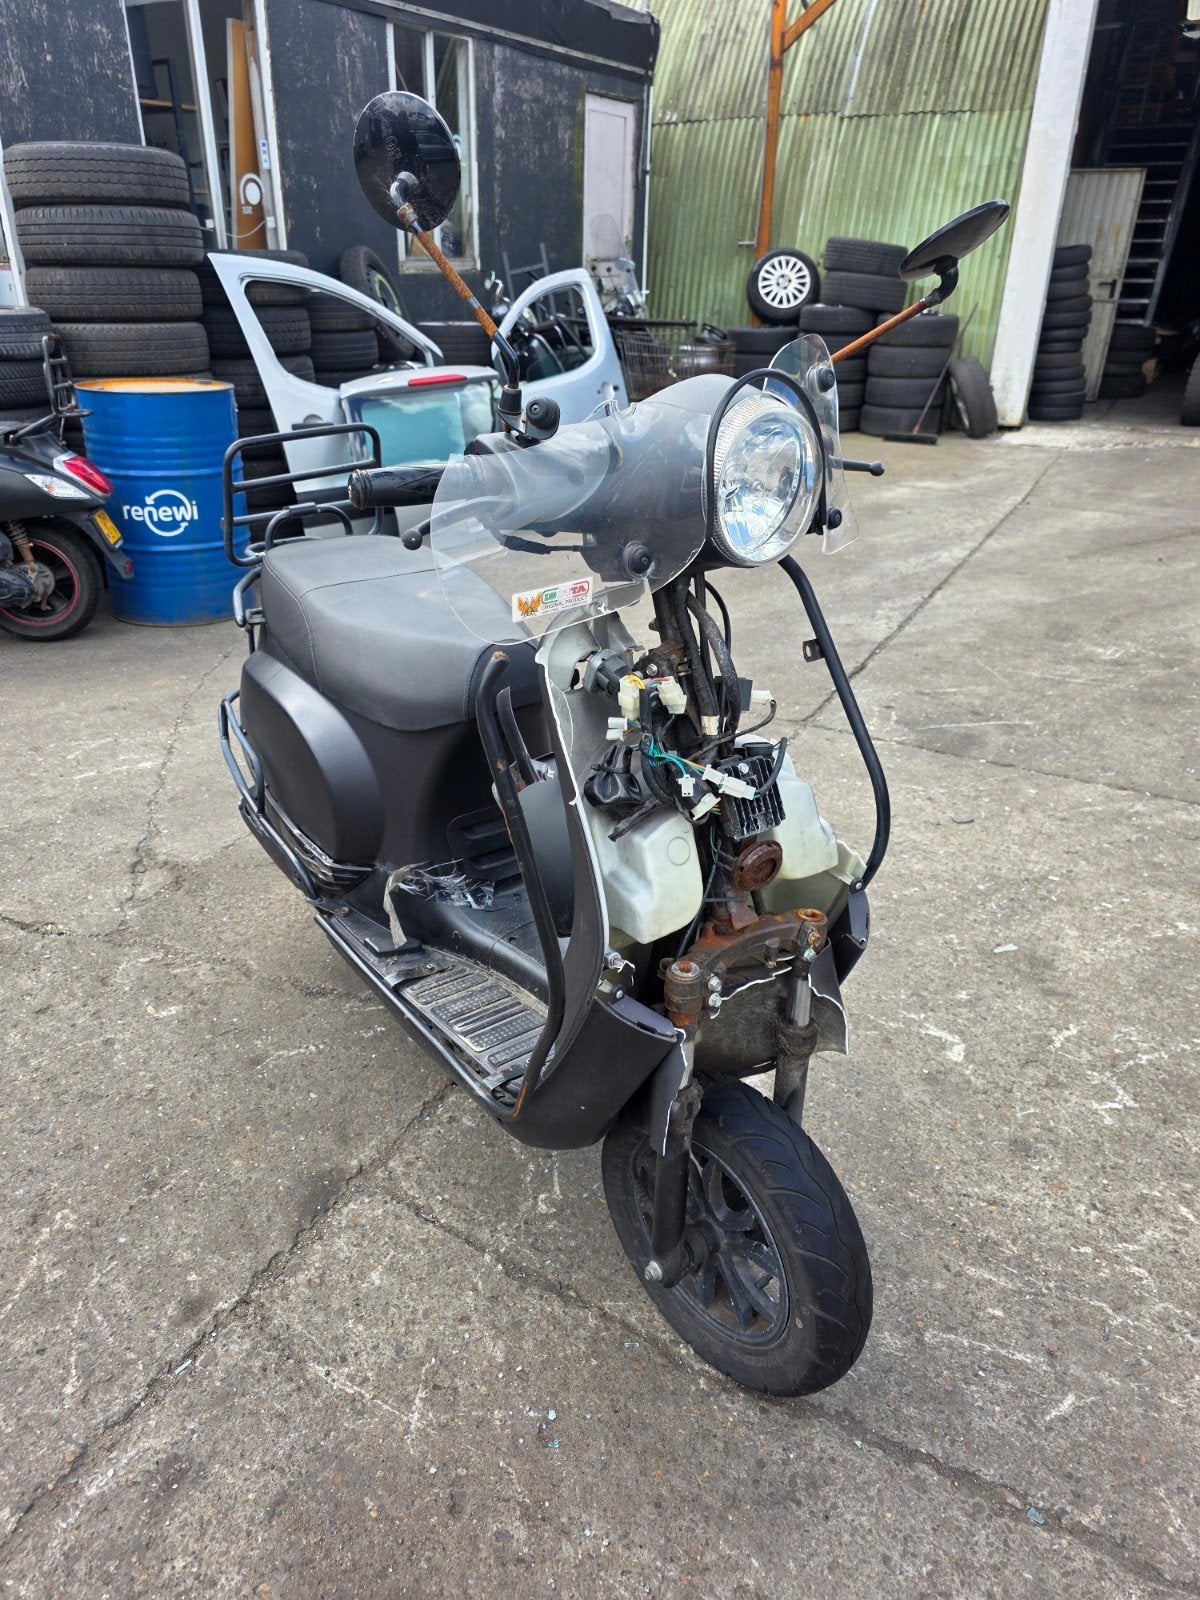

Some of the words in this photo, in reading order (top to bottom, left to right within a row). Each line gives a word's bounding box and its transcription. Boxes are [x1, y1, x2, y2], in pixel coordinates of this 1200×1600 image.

[122, 499, 199, 523] renewi
[541, 600, 564, 611] ORIGINAL
[565, 594, 588, 604] PRODUCT
